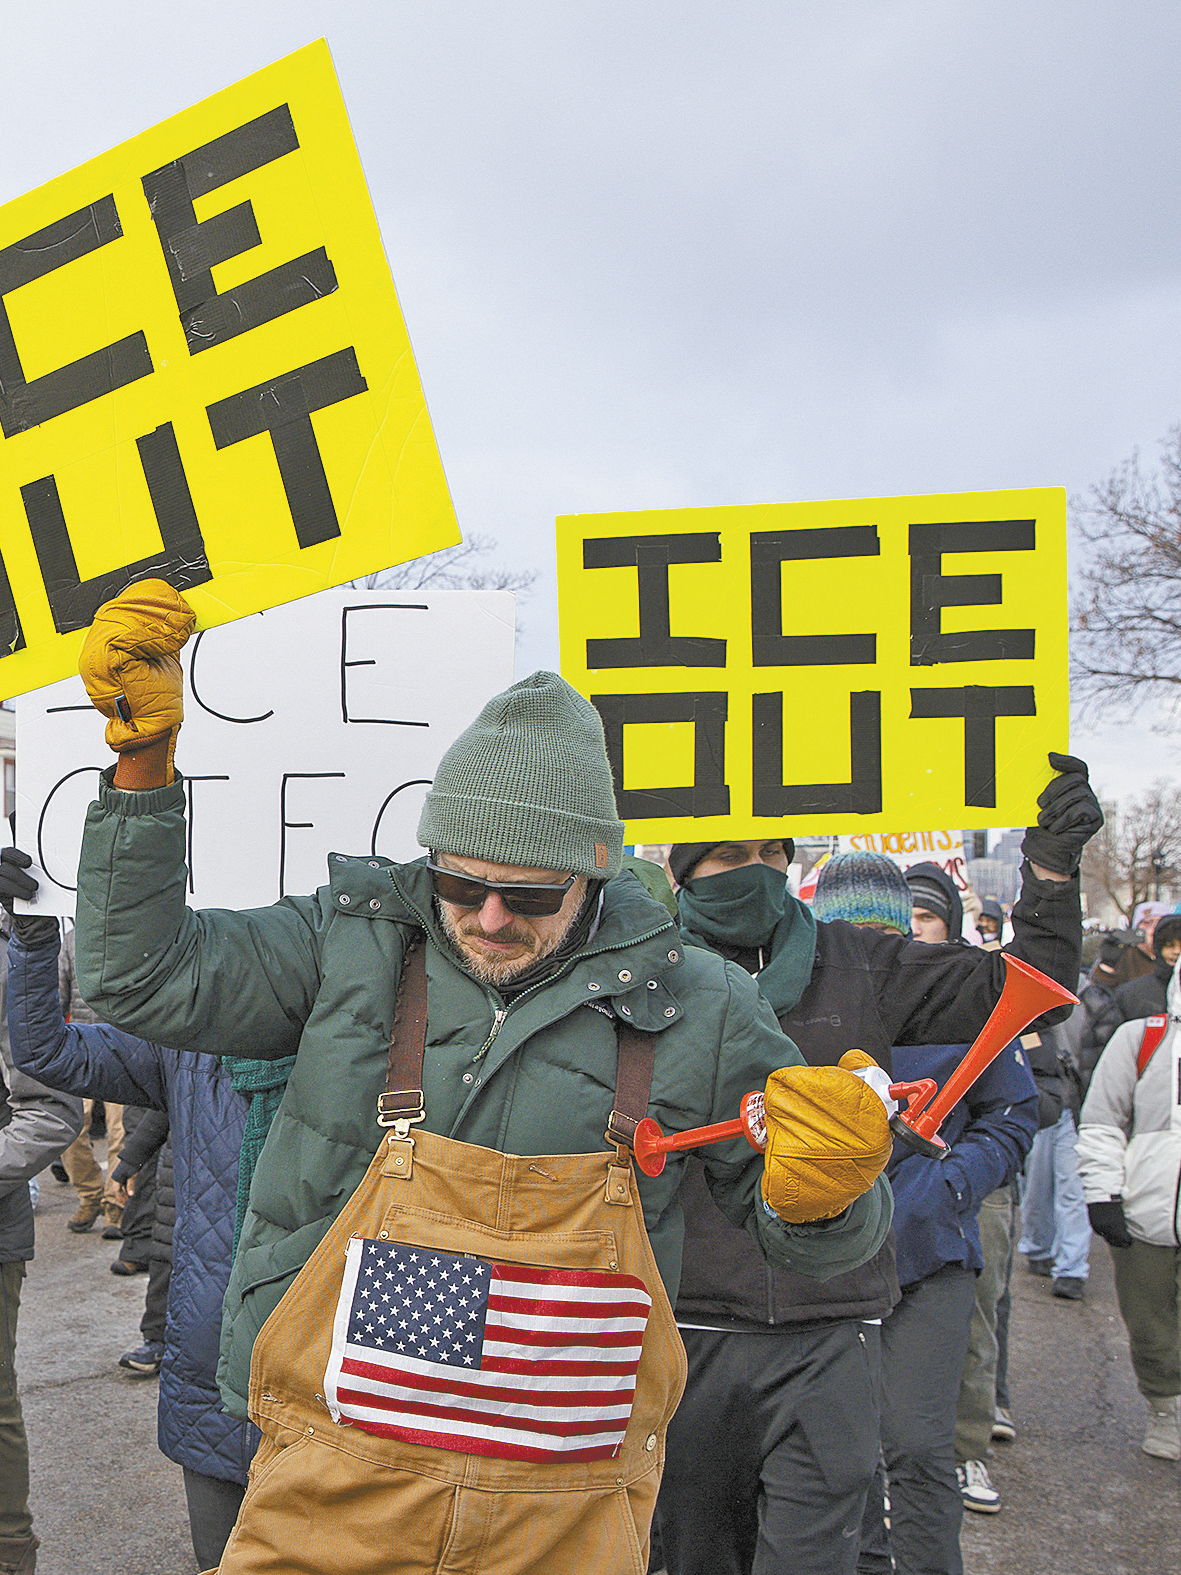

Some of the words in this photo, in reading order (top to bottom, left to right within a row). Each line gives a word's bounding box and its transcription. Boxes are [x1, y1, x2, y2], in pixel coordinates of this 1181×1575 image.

[583, 519, 1036, 669] ICE
[47, 605, 429, 727] CE
[590, 685, 1036, 818] OUT
